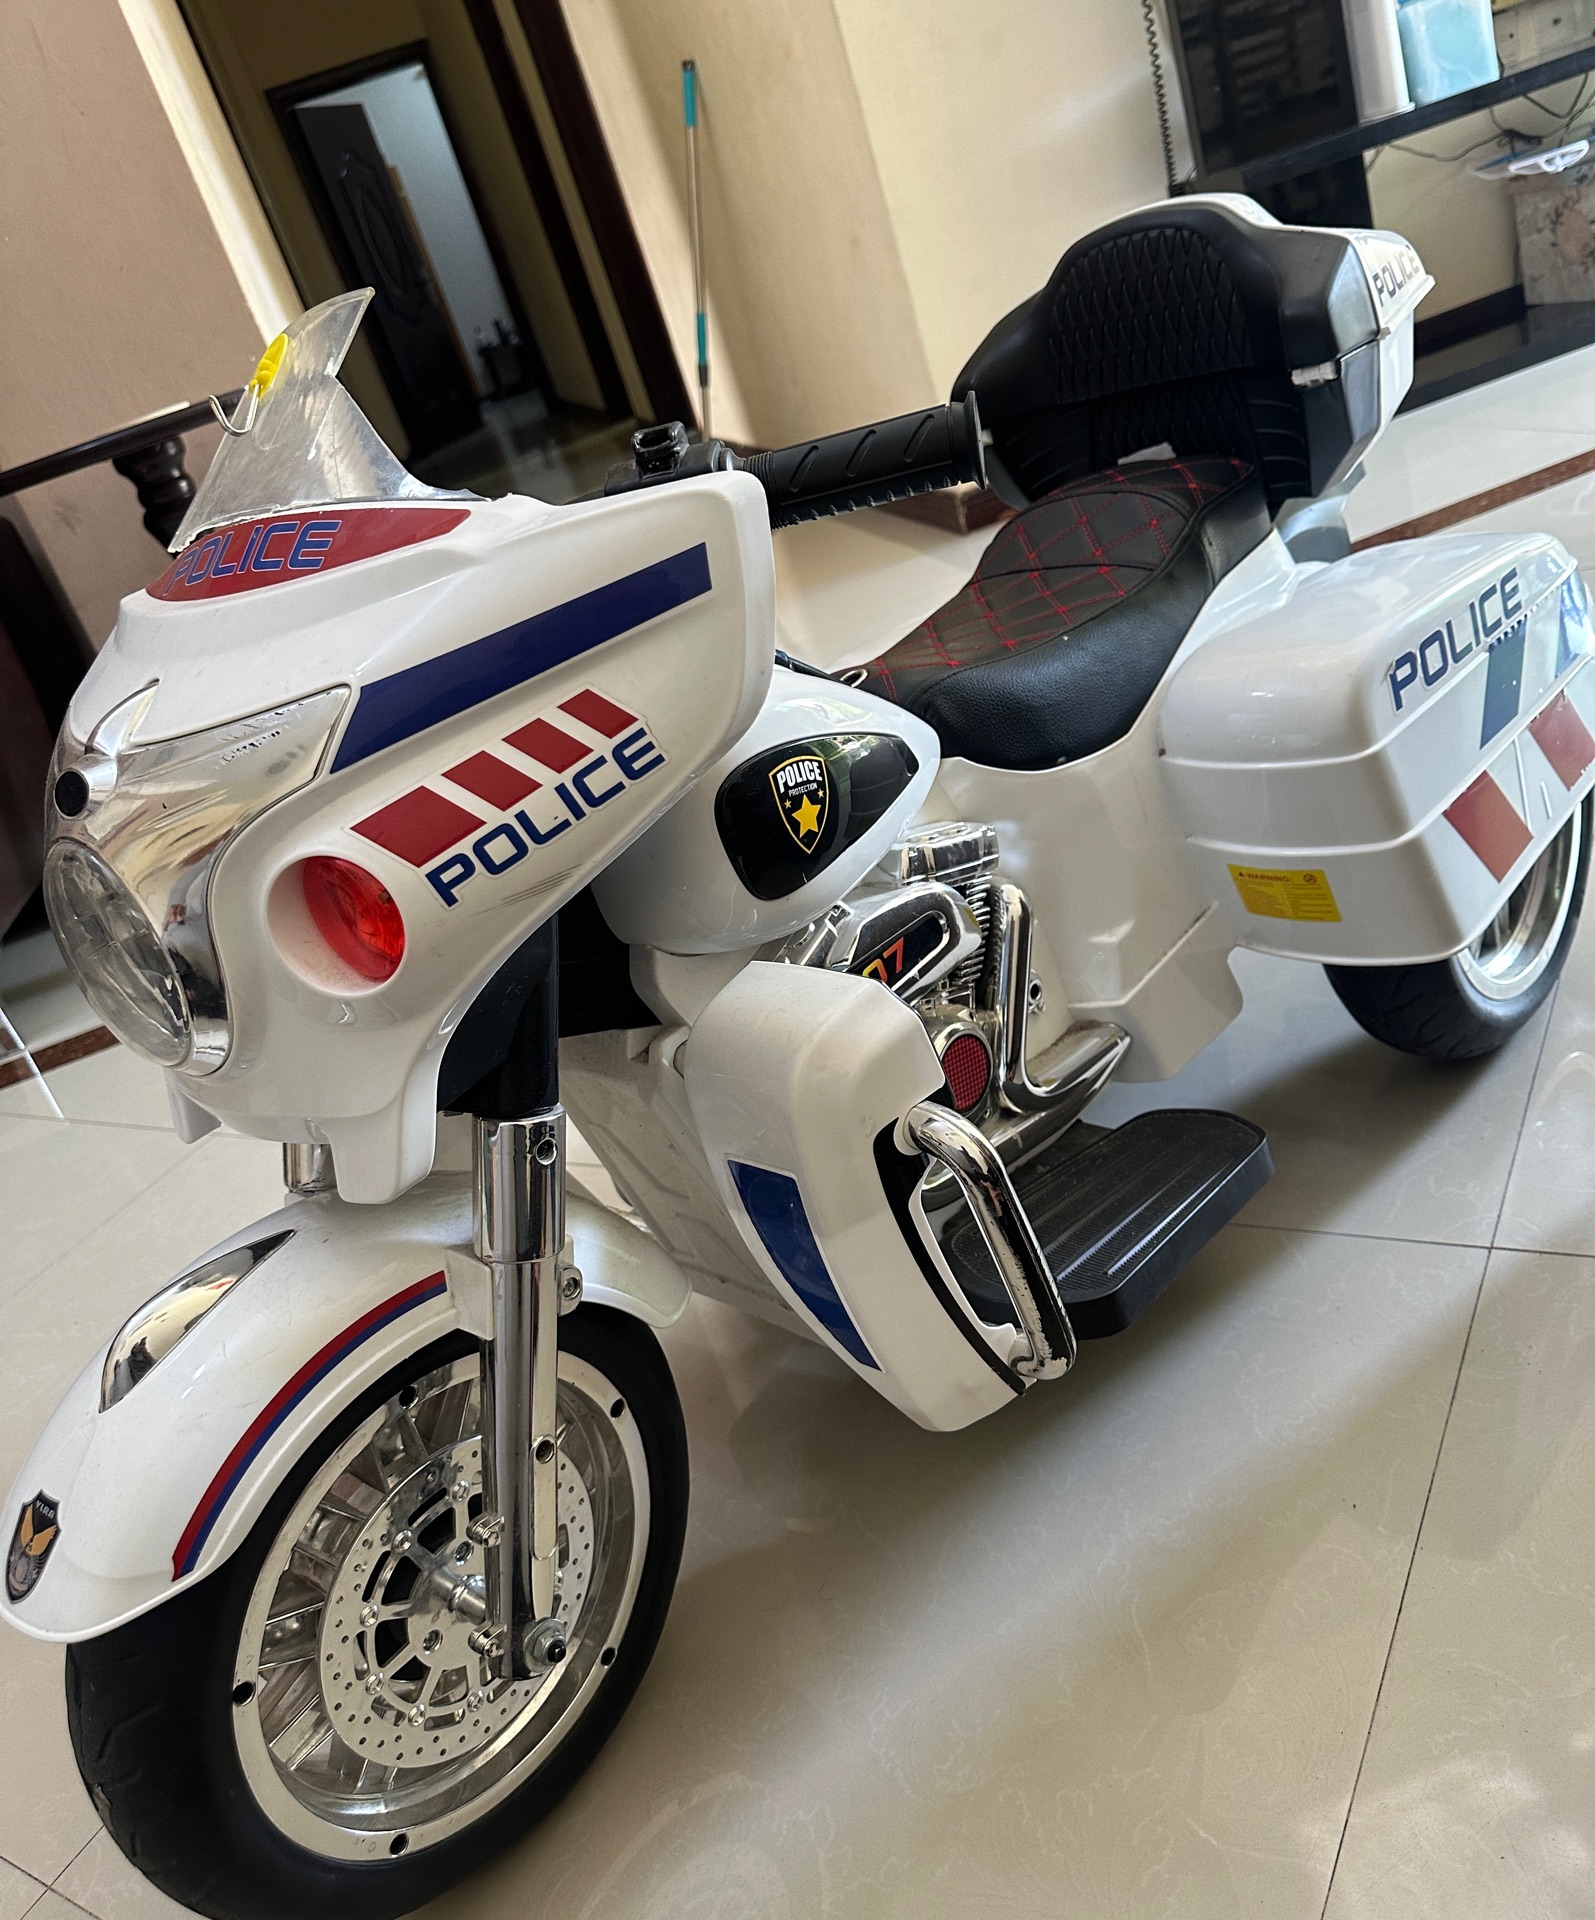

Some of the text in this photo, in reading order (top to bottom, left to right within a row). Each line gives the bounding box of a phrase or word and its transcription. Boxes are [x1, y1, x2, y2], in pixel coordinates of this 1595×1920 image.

[1372, 250, 1420, 308] POLICE
[163, 519, 342, 597] POLICE
[1389, 566, 1523, 712] POLICE
[776, 760, 823, 794] POLICE
[788, 782, 818, 797] PROTECTION
[425, 727, 666, 908] POLICE
